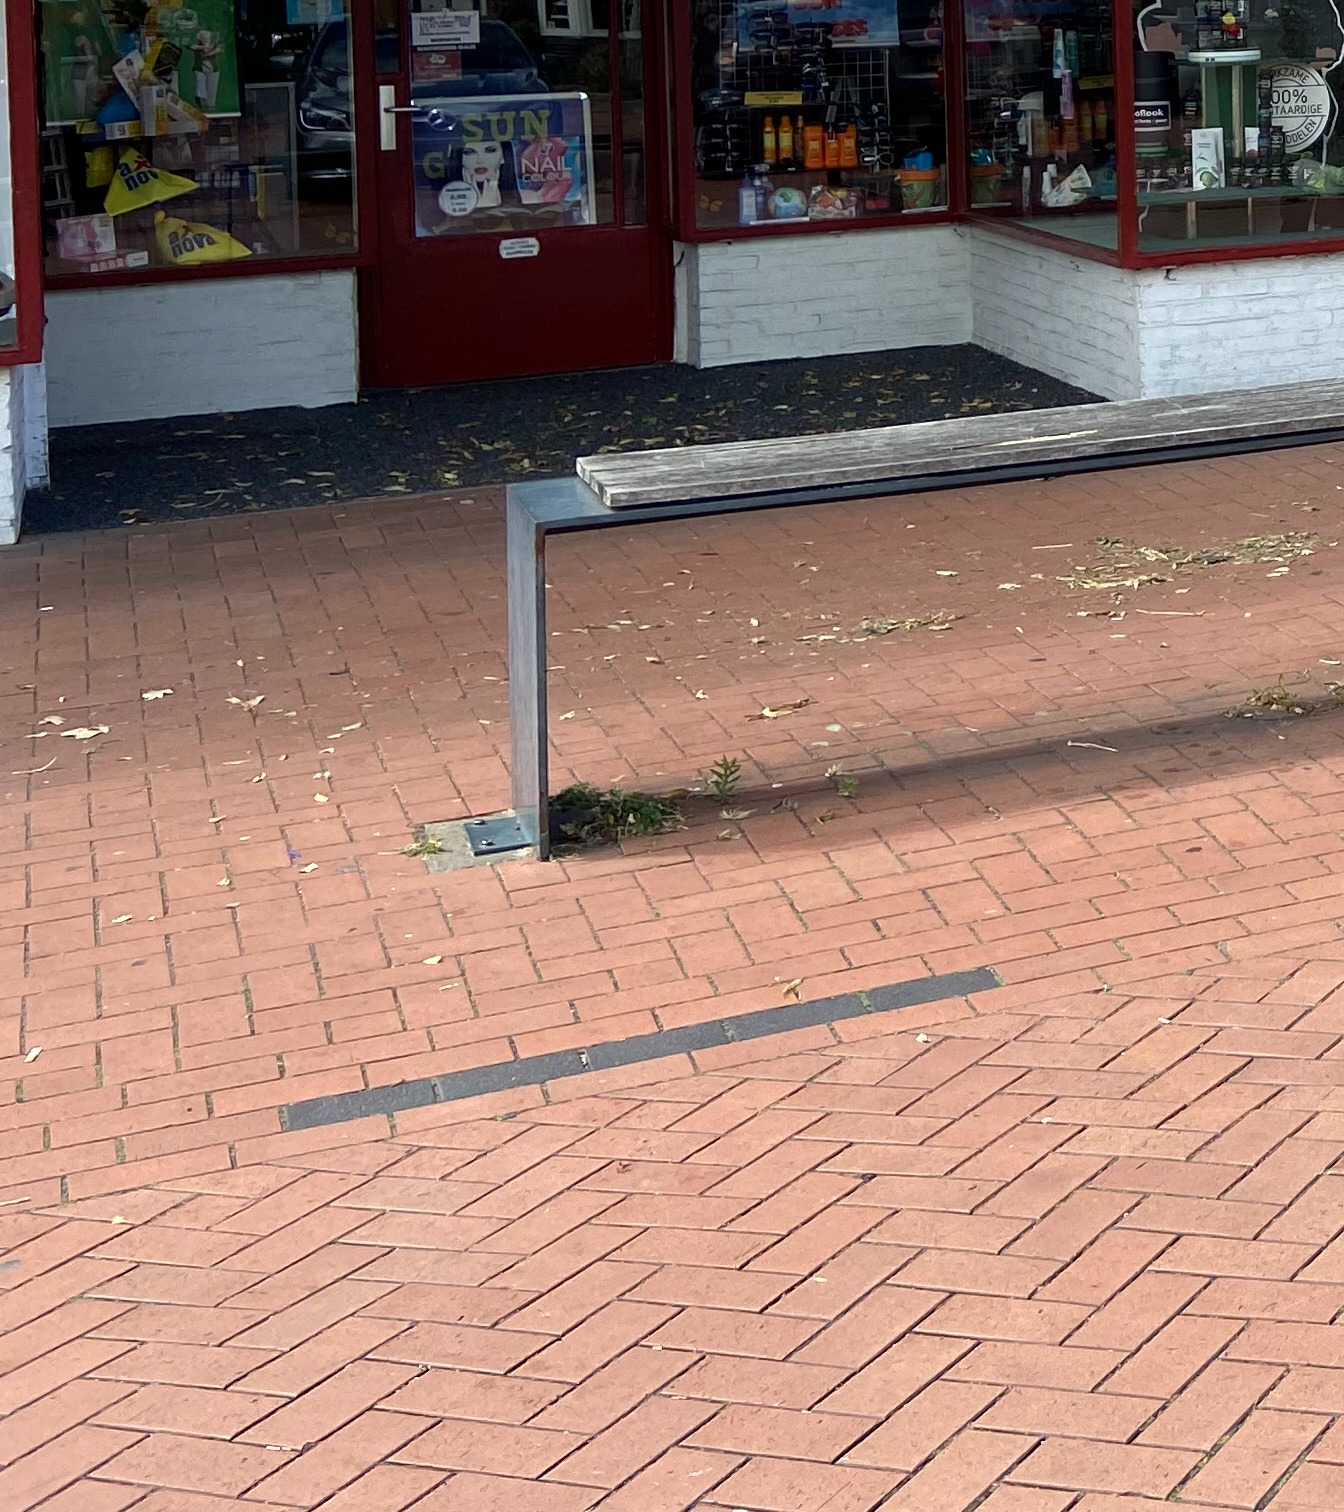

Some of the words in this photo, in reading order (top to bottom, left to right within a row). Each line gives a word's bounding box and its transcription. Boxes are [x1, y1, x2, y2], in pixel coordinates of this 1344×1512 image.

[1271, 67, 1310, 85] RKZAME
[1271, 88, 1308, 104] 00%
[1271, 104, 1323, 116] TAARDIGE
[462, 109, 551, 143] SUN
[1285, 118, 1317, 145] DDELEN
[521, 155, 573, 174] NAIL
[522, 171, 573, 183] COLOUR
